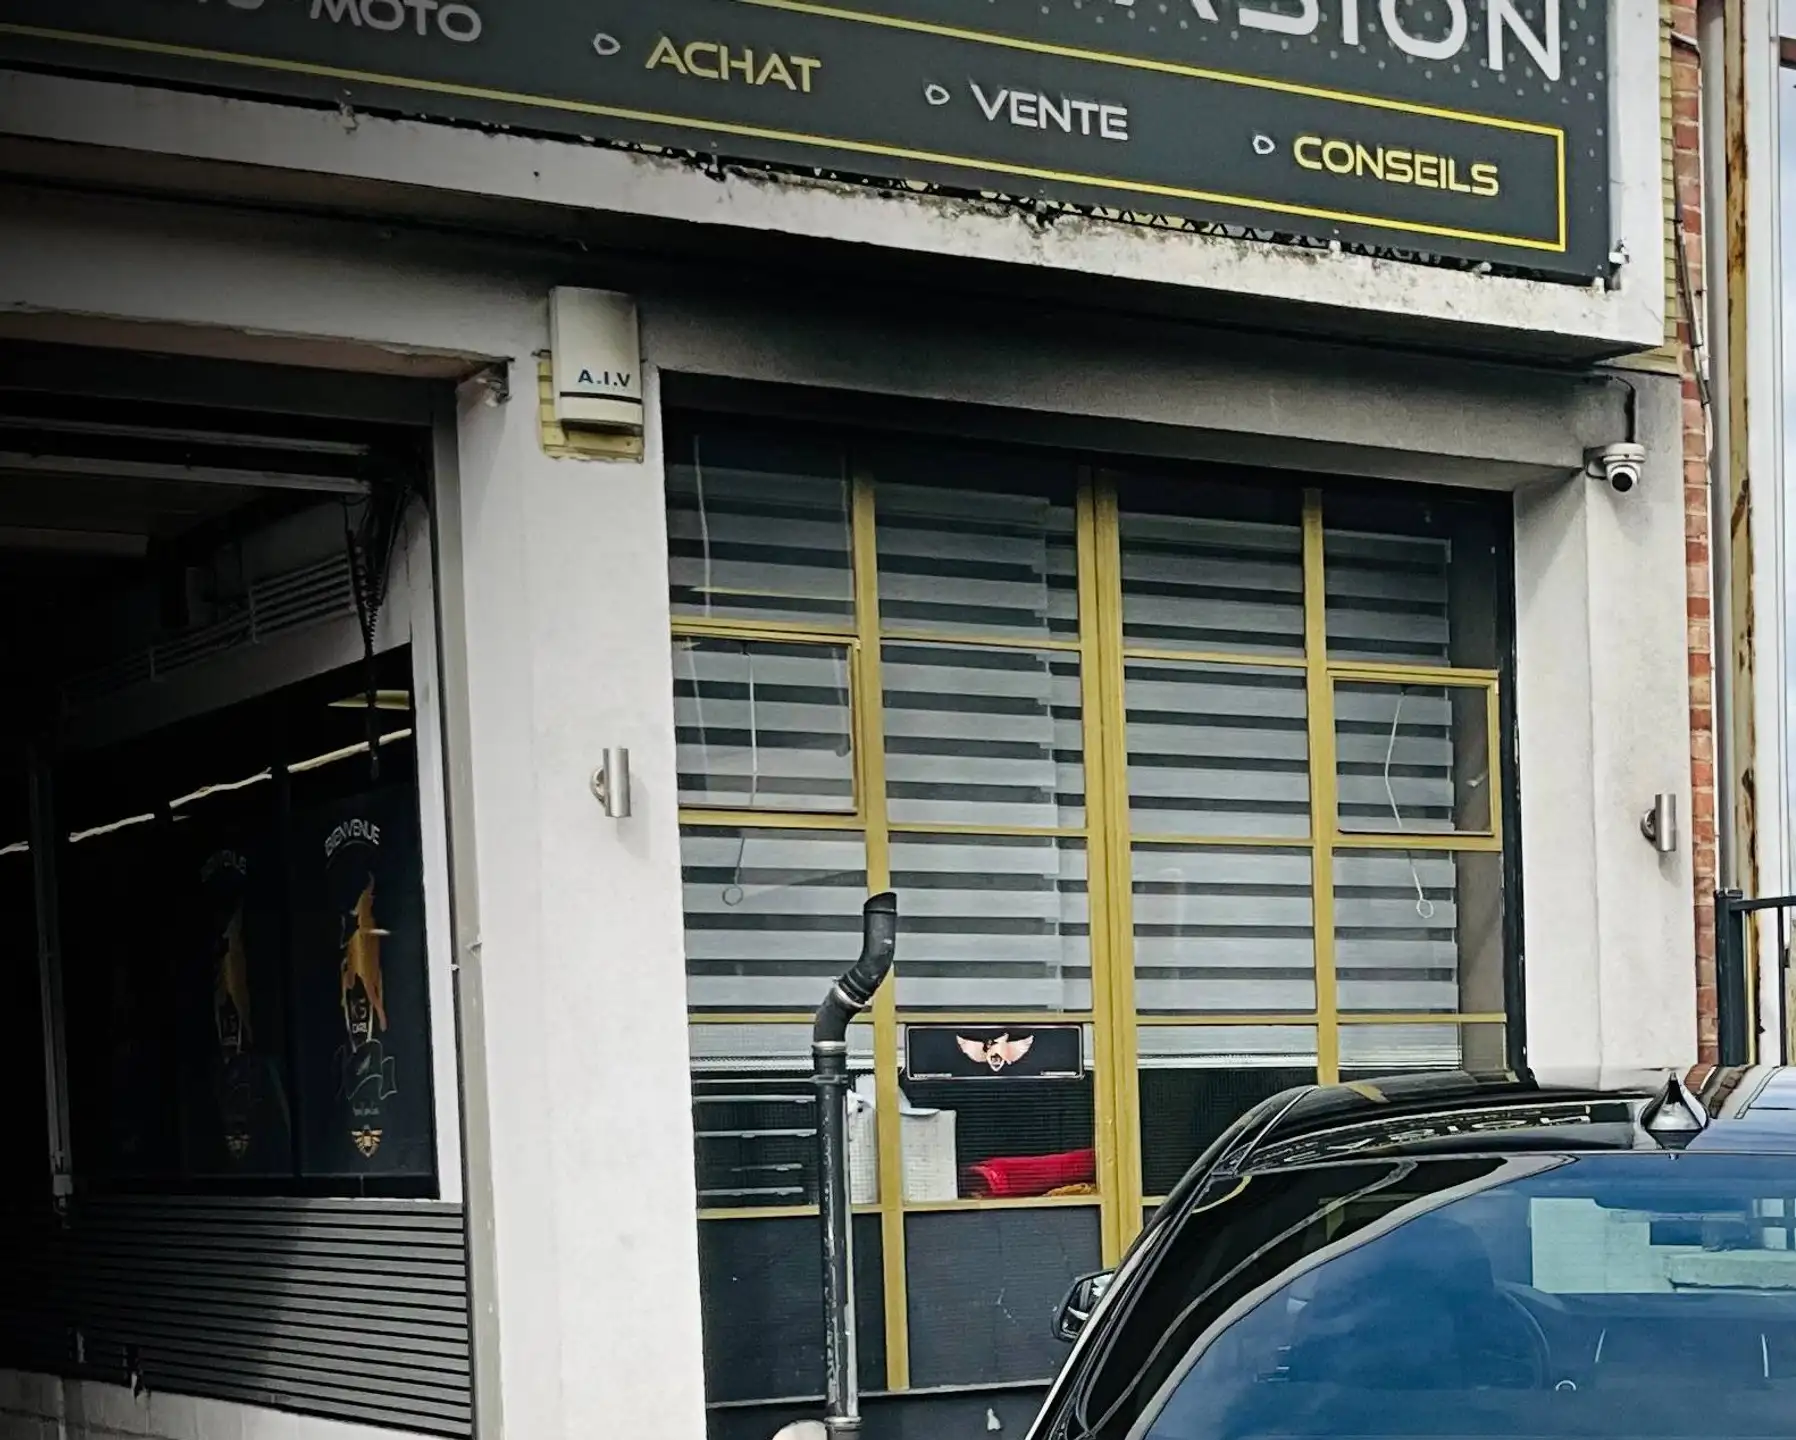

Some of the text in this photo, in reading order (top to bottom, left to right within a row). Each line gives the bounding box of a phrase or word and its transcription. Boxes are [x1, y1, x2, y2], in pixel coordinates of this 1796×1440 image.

[310, 0, 482, 42] MOTO
[645, 36, 822, 93] ACHAT
[971, 83, 1129, 141] VENTE
[1293, 136, 1499, 196] CONSEILS
